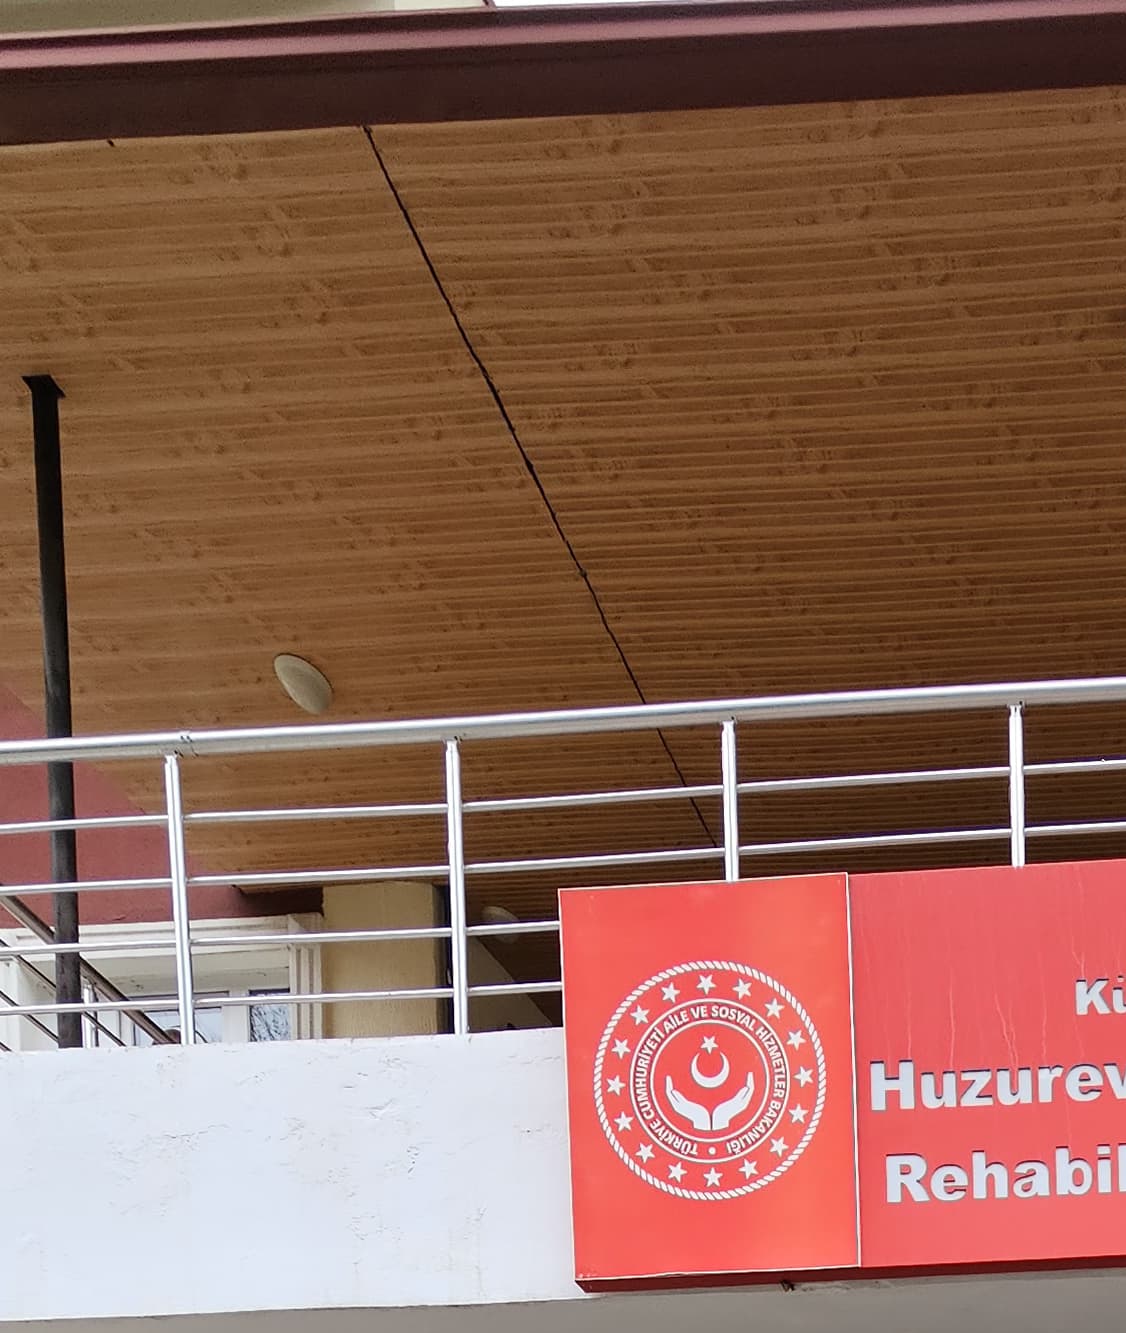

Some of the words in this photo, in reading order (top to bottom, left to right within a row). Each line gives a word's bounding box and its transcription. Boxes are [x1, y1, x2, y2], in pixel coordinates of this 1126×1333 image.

[663, 1010, 689, 1034] AİLE
[690, 1006, 708, 1019] VE
[711, 1005, 755, 1031] SOSYAL
[635, 1027, 664, 1120] CUMHURİYETİ
[755, 1026, 786, 1098] HİZMETLER
[650, 1118, 698, 1155] TÜRKİYE
[726, 1101, 781, 1155] BAKANLIĞI
